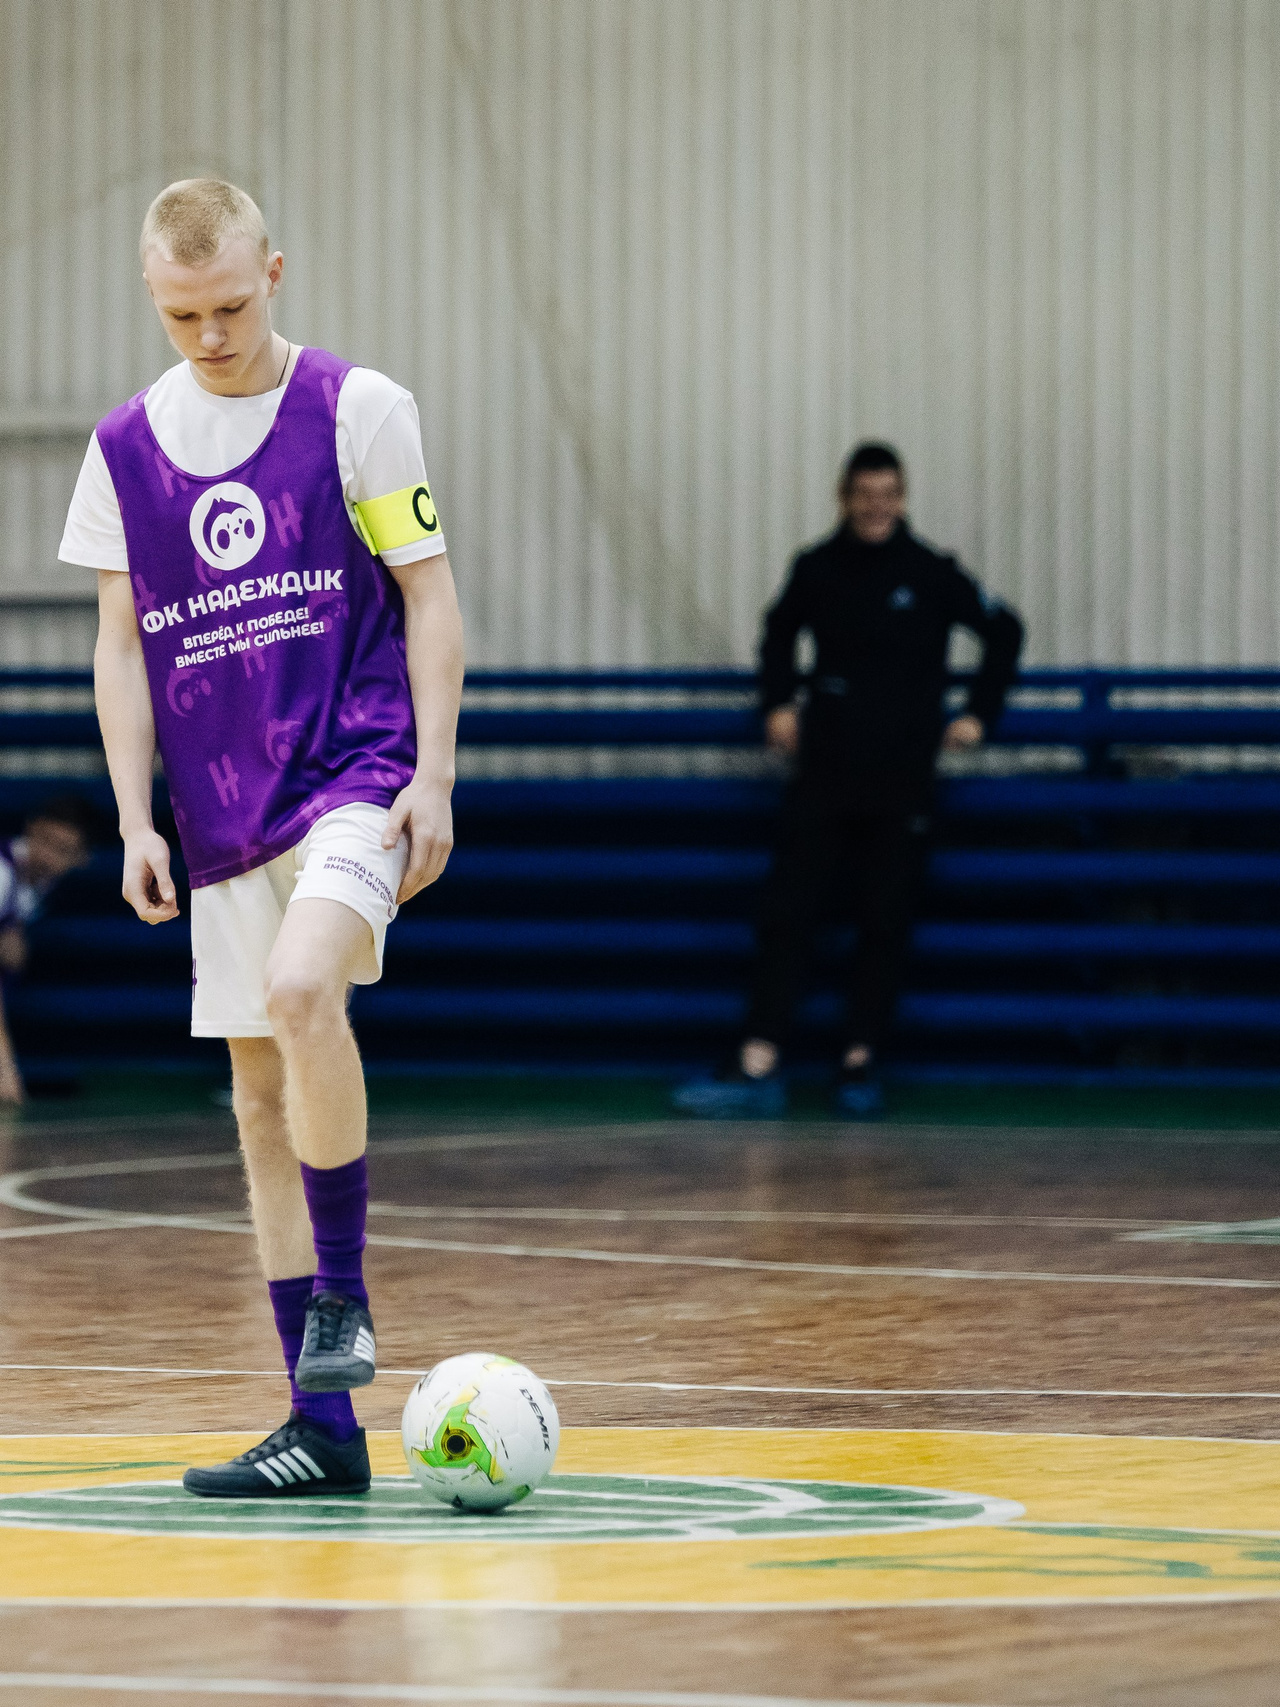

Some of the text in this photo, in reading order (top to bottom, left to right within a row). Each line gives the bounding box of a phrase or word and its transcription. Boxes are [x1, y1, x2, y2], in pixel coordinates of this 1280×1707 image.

[142, 569, 343, 633] ФК НАДЕЖДИК
[174, 621, 325, 669] ВМЕСТЕ МЫ СИЛЬНЕЕ!
[182, 607, 310, 650] ВПЕРЁД К ПОБЕДЕ!
[323, 863, 380, 893] ВМЕСТЕ МЫ
[326, 855, 366, 875] ВПЕРЁД
[367, 871, 374, 879] К
[375, 877, 394, 906] ПОБЕД
[519, 1388, 550, 1452] DEMIX
